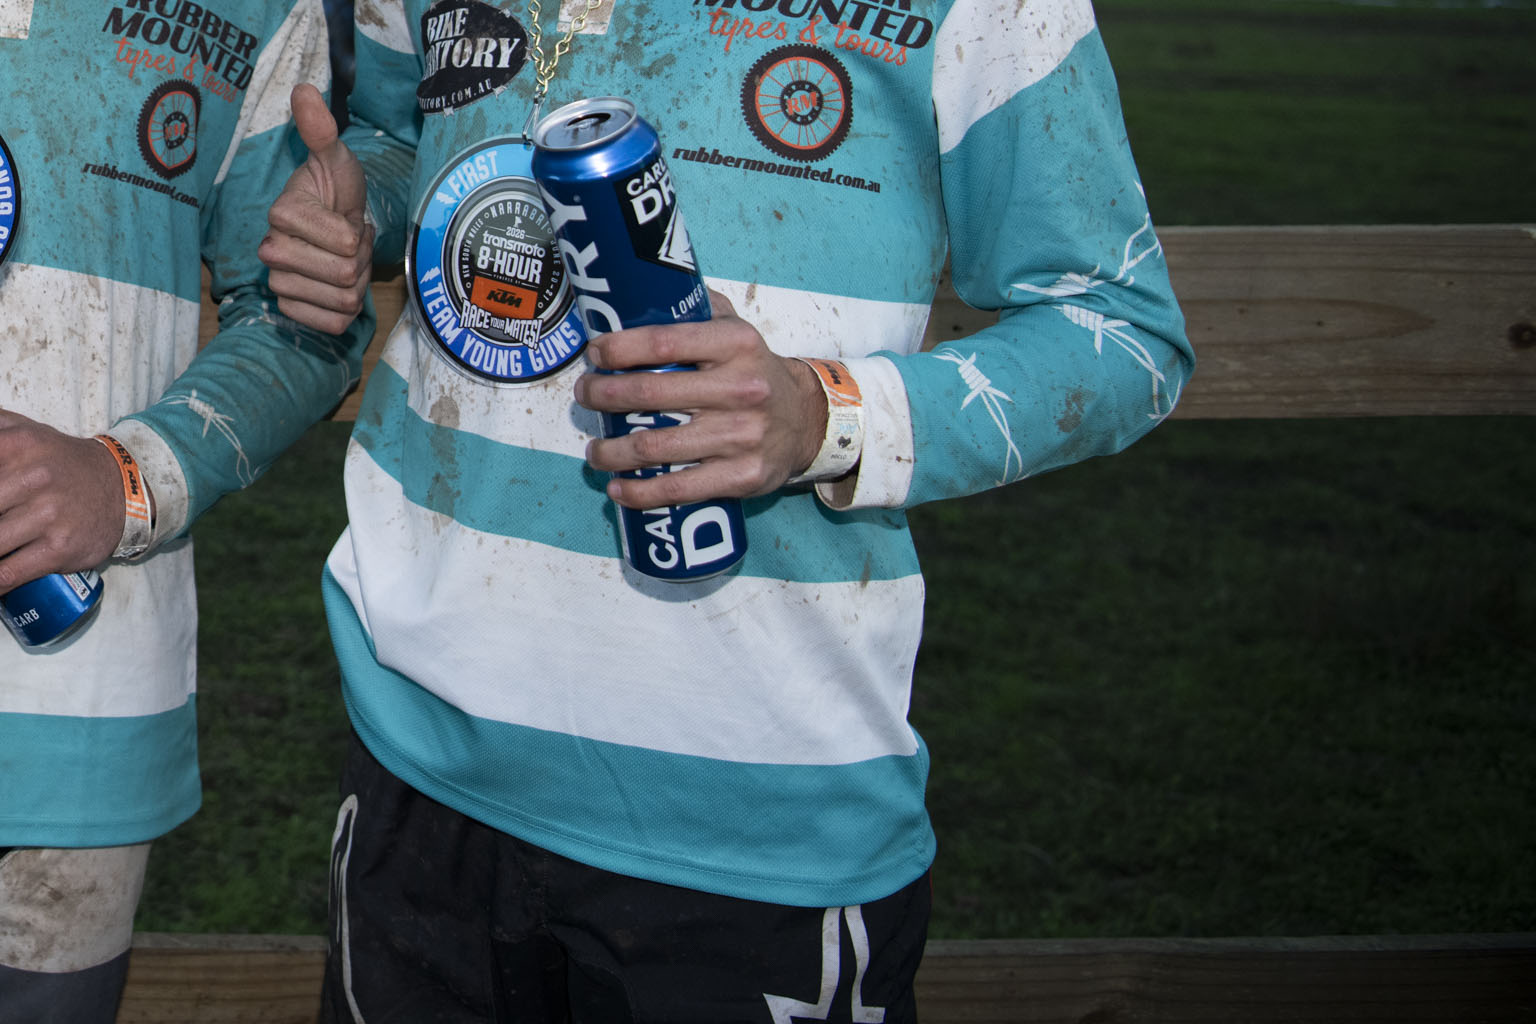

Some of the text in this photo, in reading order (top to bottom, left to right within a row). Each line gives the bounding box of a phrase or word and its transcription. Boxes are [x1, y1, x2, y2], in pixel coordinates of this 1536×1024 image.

[102, 7, 254, 90] MOUNTED
[708, 7, 908, 66] tyres & tours
[114, 36, 239, 103] tyres & tours
[786, 91, 817, 115] RM
[448, 150, 499, 198] FIRST
[672, 146, 881, 193] rubbermounted.com.au
[489, 200, 551, 231] NARRABRI
[629, 169, 677, 226] DR
[482, 230, 546, 258] transmoto
[506, 226, 526, 239] 2026
[477, 246, 543, 284] 8-HOUR
[487, 288, 523, 308] KTM
[670, 283, 705, 320] LOWER
[423, 284, 583, 376] TEAM YOUNG GUNS
[460, 299, 544, 351] RACE YOUR MATES!
[13, 608, 41, 628] CARB
